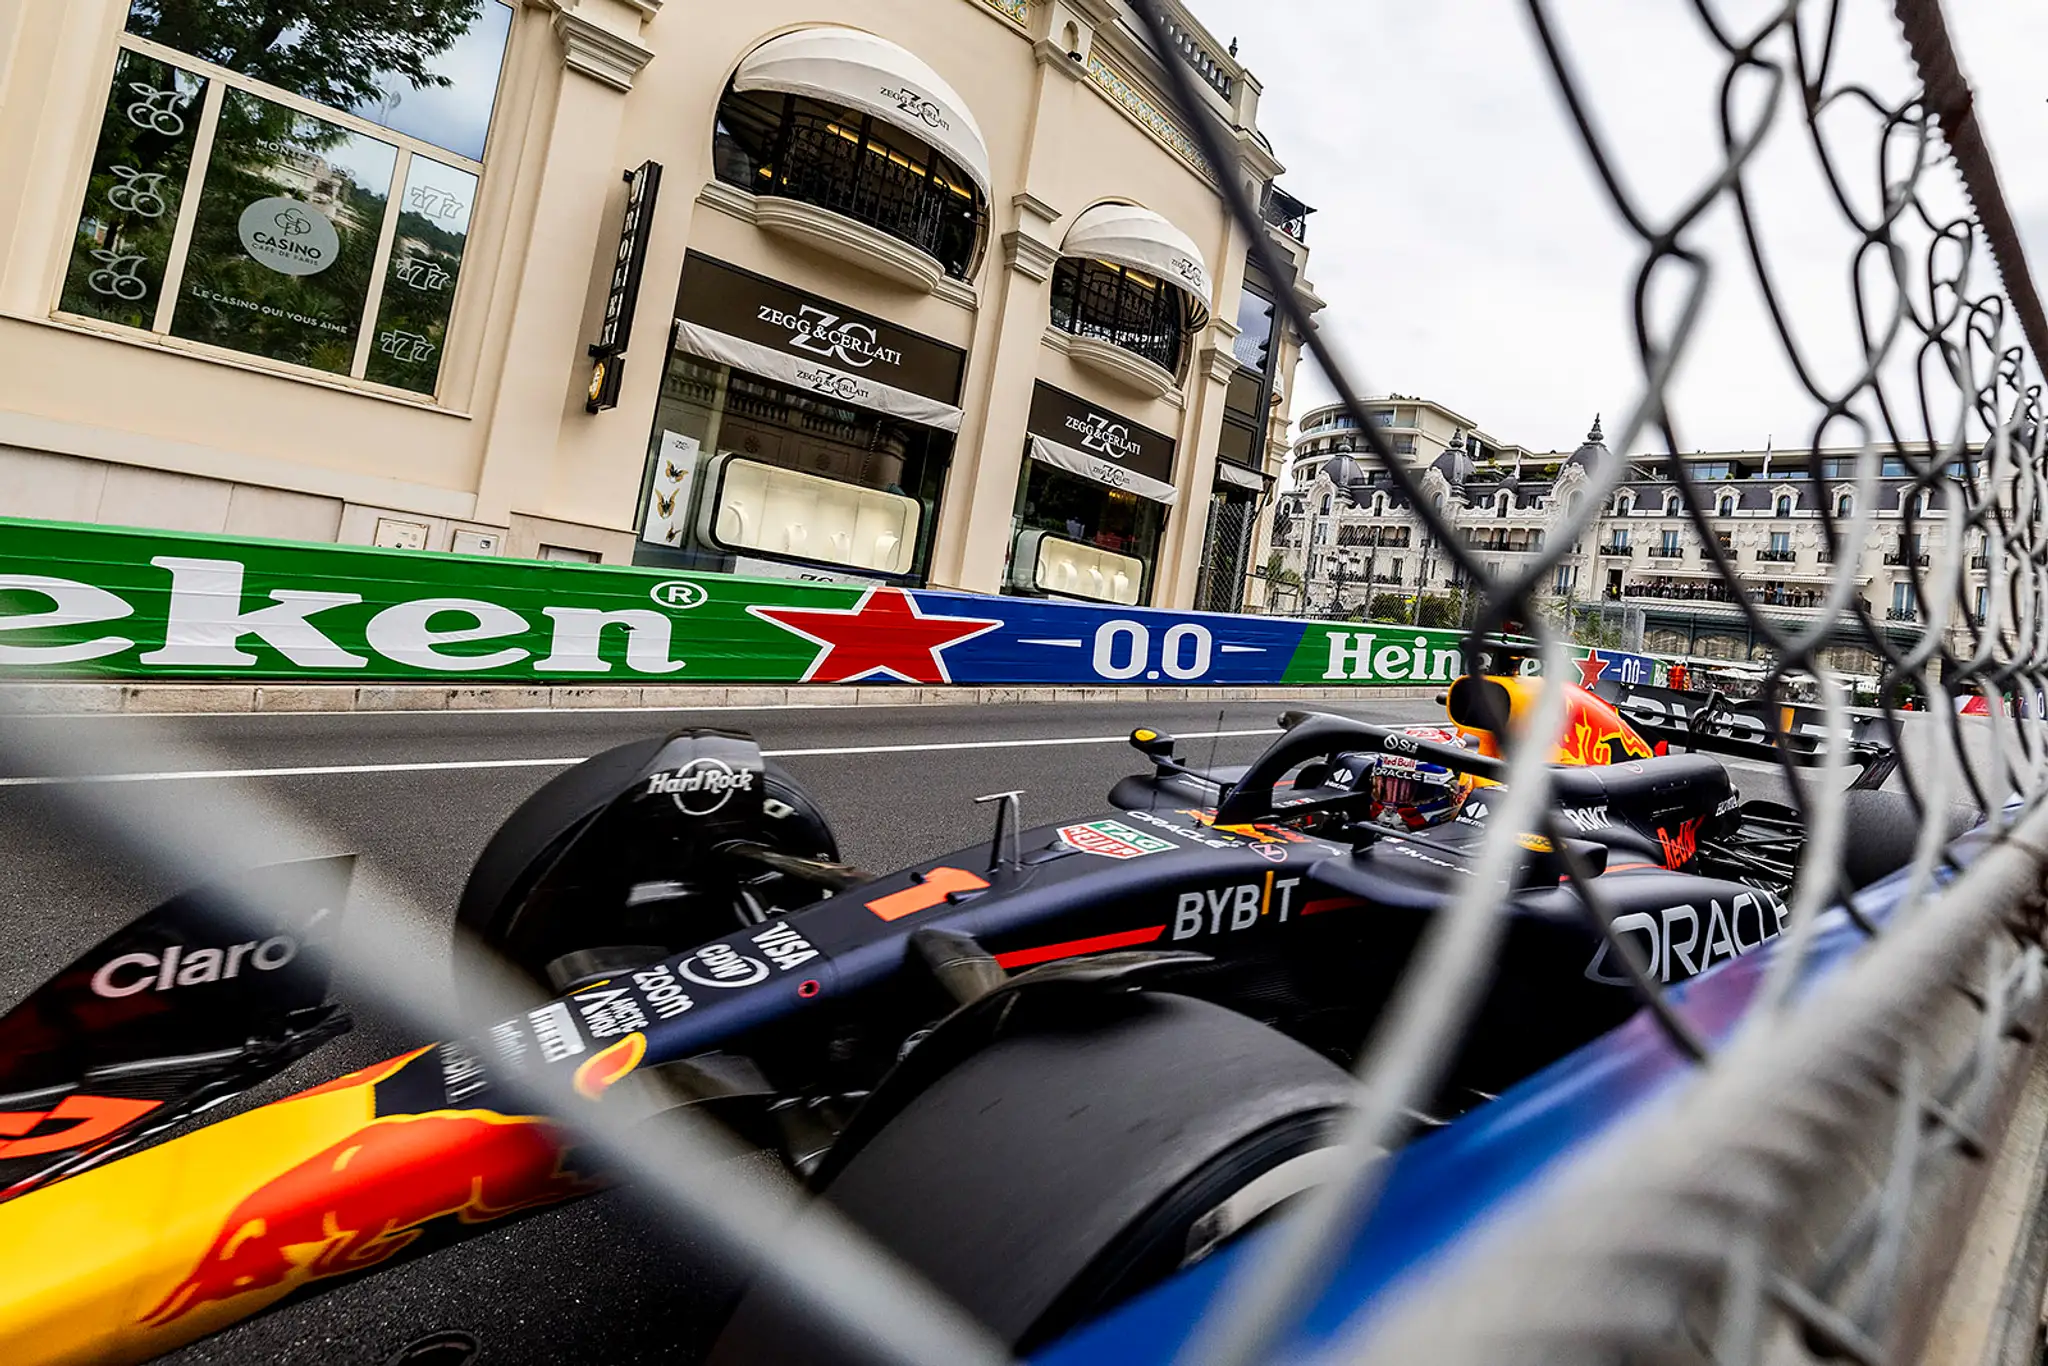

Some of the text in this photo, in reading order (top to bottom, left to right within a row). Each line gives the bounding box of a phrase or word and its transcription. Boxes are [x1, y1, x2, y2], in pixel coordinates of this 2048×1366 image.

[411, 185, 464, 219] 777
[253, 231, 322, 259] CASINO
[396, 257, 451, 290] 777
[191, 286, 348, 334] LE CASINO QUI VOUS AIME
[380, 329, 436, 362] 777
[757, 305, 811, 334] ZEGG
[828, 330, 902, 366] CERLATI
[796, 370, 822, 384] ZEGG
[1064, 415, 1094, 436] ZEGG
[1102, 431, 1141, 456] CERLATI
[1092, 619, 1212, 680] 0.0
[1383, 756, 1416, 768] Red Bull
[1398, 739, 1419, 754] Sui
[647, 768, 753, 795] Hard Rock
[1373, 767, 1422, 781] ORACLE
[1126, 811, 1225, 849] ORACLE
[1564, 806, 1612, 832] ROKT
[1066, 826, 1148, 858] HEUER
[1098, 822, 1164, 850] TAG
[1172, 870, 1300, 941] BYBIT
[696, 943, 752, 979] CDW
[750, 921, 820, 971] VISA
[90, 934, 296, 998] Claro
[584, 1007, 624, 1038] WOLF
[607, 997, 649, 1032] ARCTIC
[528, 1001, 587, 1063] PIRELLI
